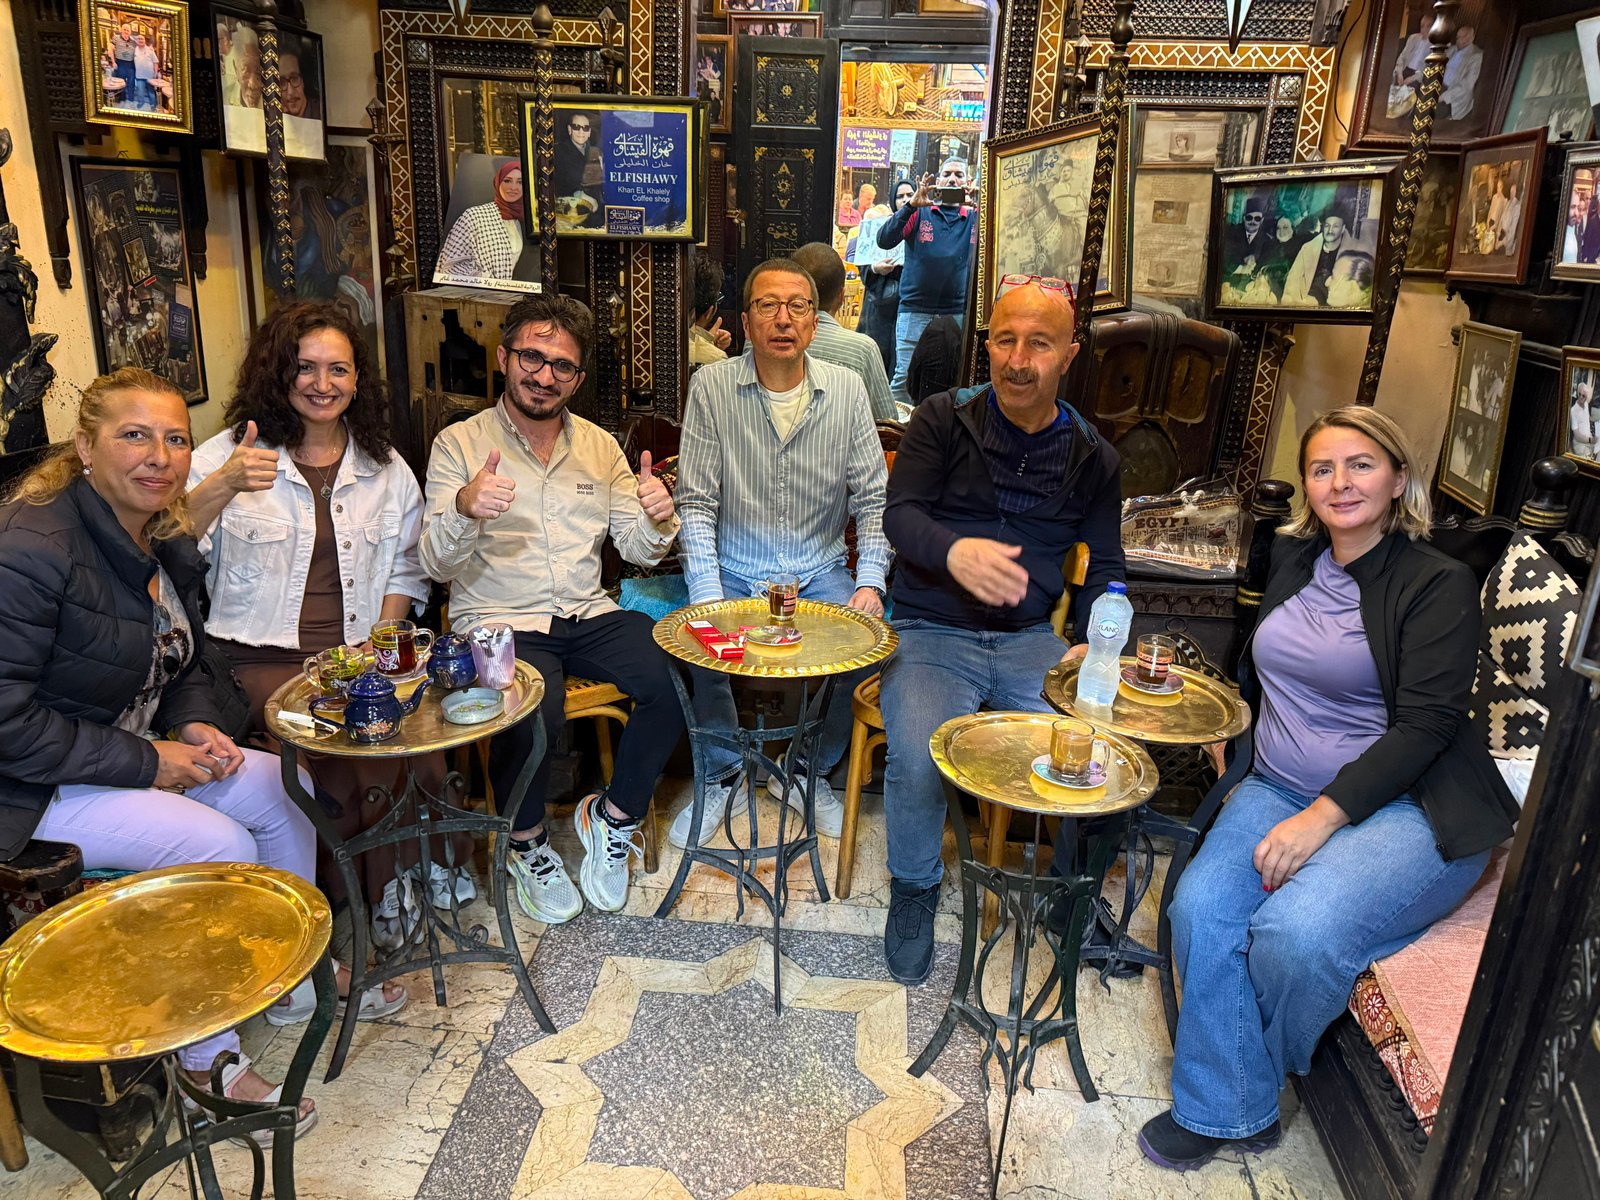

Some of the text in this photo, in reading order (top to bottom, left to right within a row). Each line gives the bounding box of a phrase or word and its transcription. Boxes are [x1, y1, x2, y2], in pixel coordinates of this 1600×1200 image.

[609, 171, 678, 184] ELFISHAWY
[618, 186, 635, 194] Khan
[646, 187, 671, 196] Khalely
[632, 194, 671, 204] Coffee shop
